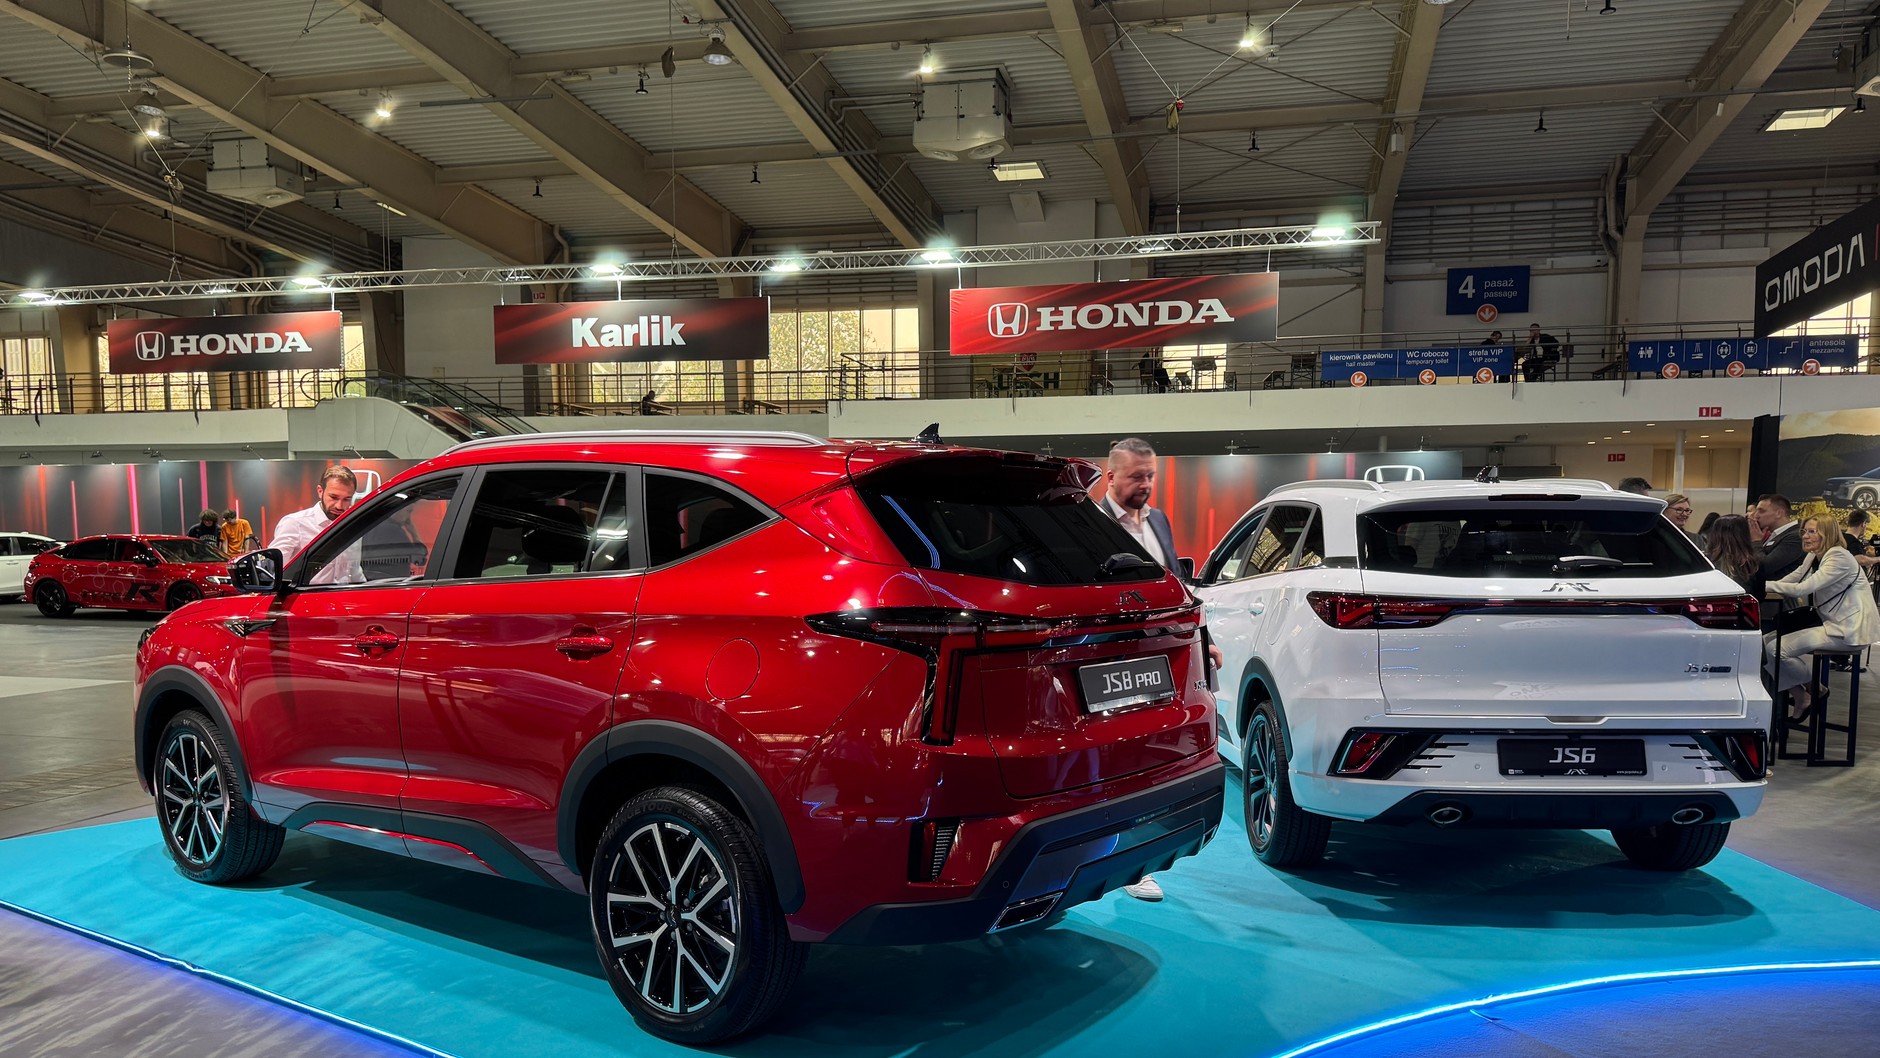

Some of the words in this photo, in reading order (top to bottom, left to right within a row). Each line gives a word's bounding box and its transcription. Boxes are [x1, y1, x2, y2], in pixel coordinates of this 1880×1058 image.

[1765, 233, 1865, 312] OMODA
[1458, 275, 1476, 299] 4
[1484, 278, 1514, 289] pasaż
[1484, 290, 1518, 299] passage
[1036, 298, 1235, 331] HONDA
[572, 315, 686, 347] Karlik
[170, 331, 312, 356] HONDA
[1490, 348, 1503, 356] VIP
[1809, 338, 1846, 347] antresola
[1329, 353, 1361, 361] kierownik
[1362, 352, 1393, 361] pawilonu
[124, 583, 161, 603] R
[1102, 670, 1133, 694] JS8
[1135, 671, 1162, 688] PRO
[1549, 747, 1597, 764] JS6
